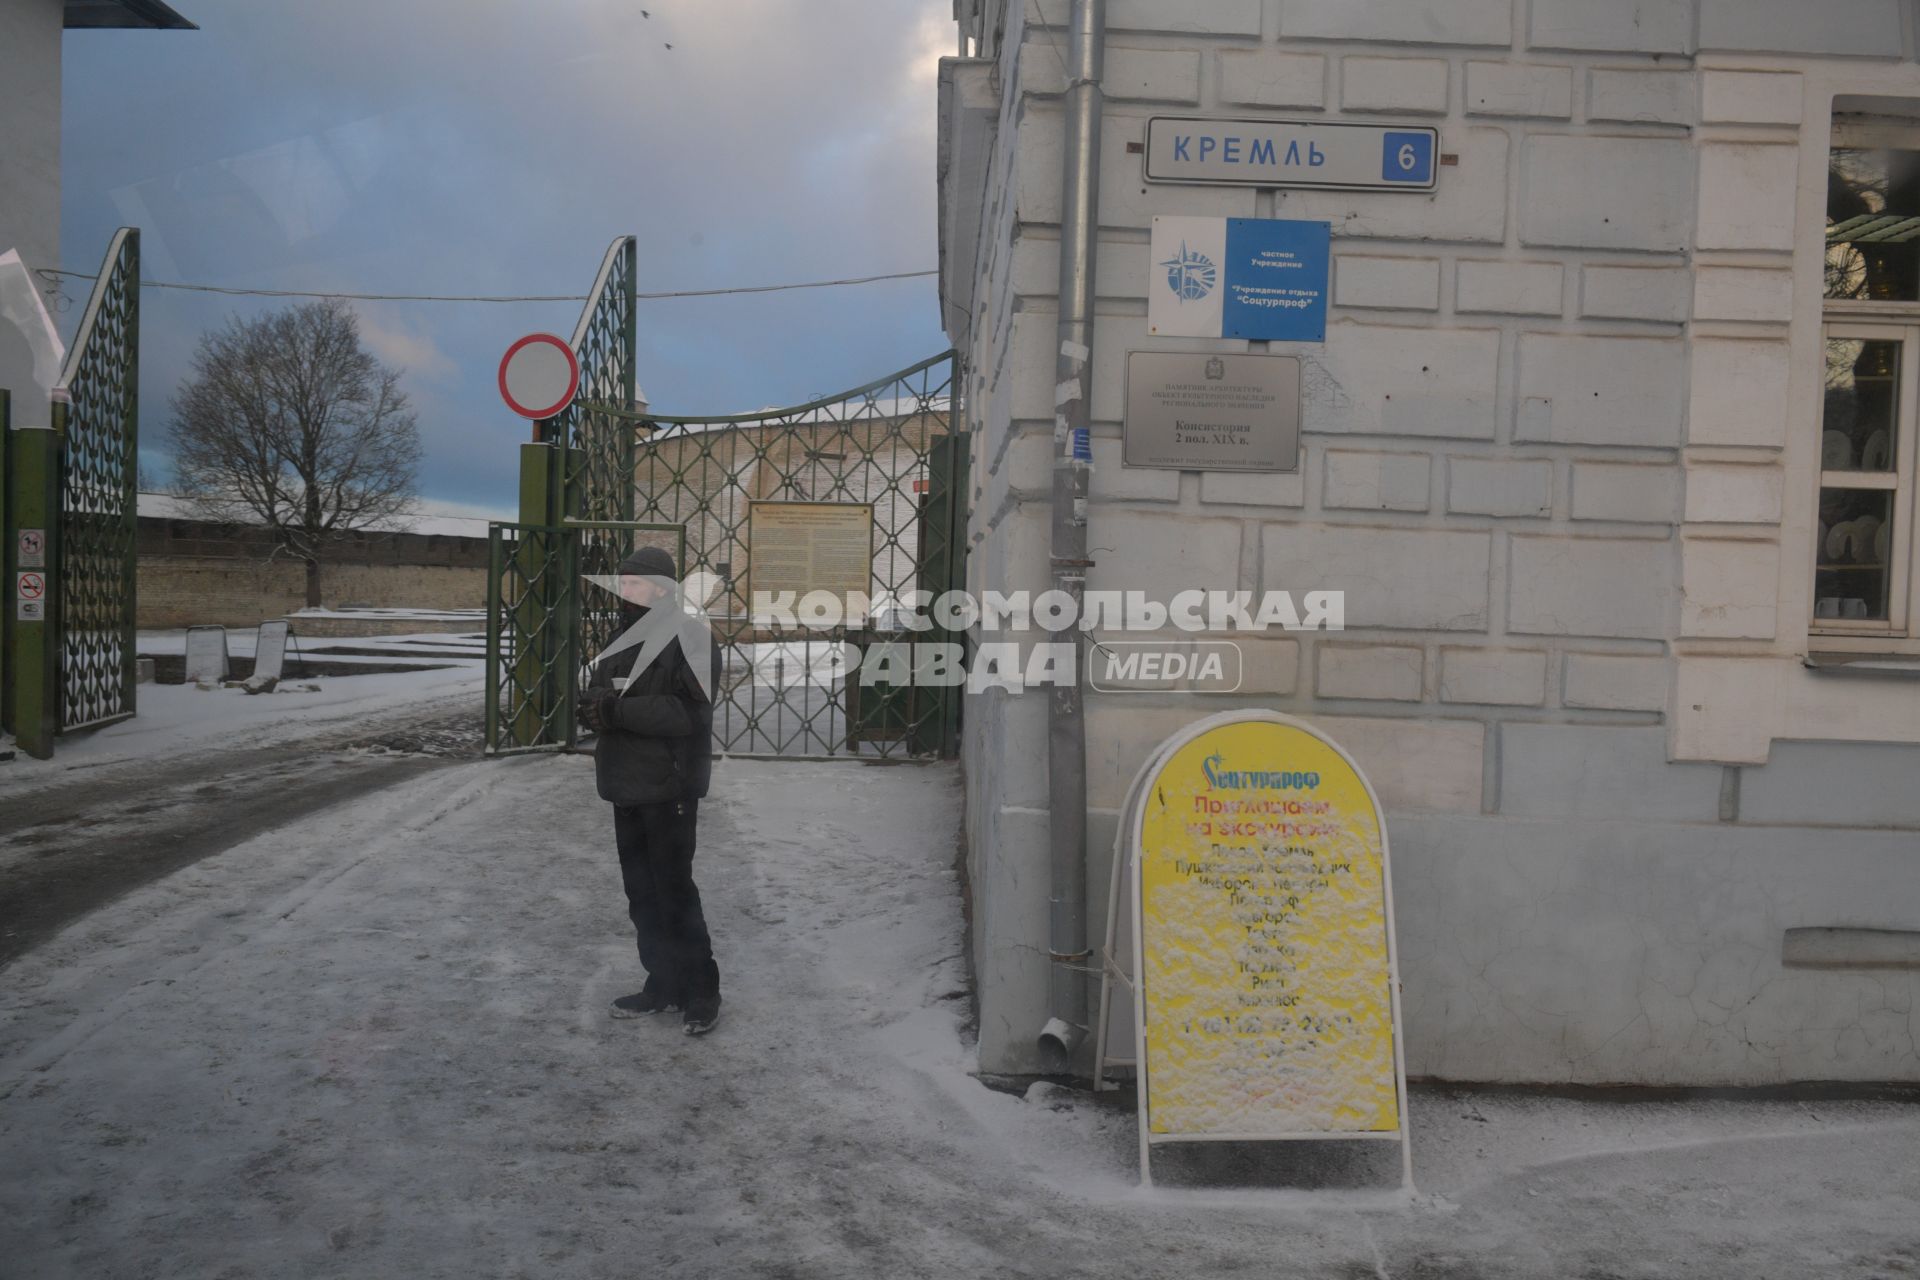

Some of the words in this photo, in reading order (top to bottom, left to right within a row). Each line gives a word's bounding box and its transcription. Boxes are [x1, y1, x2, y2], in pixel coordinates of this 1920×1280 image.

[1173, 136, 1325, 167] КРЕМЛЬ
[1398, 143, 1416, 170] 6
[1251, 258, 1303, 269] Учреждение
[1289, 288, 1319, 297] отдыха
[1175, 420, 1251, 434] Консистория
[1175, 433, 1182, 443] 2
[1185, 435, 1209, 444] пол.
[1212, 434, 1236, 445] XIX
